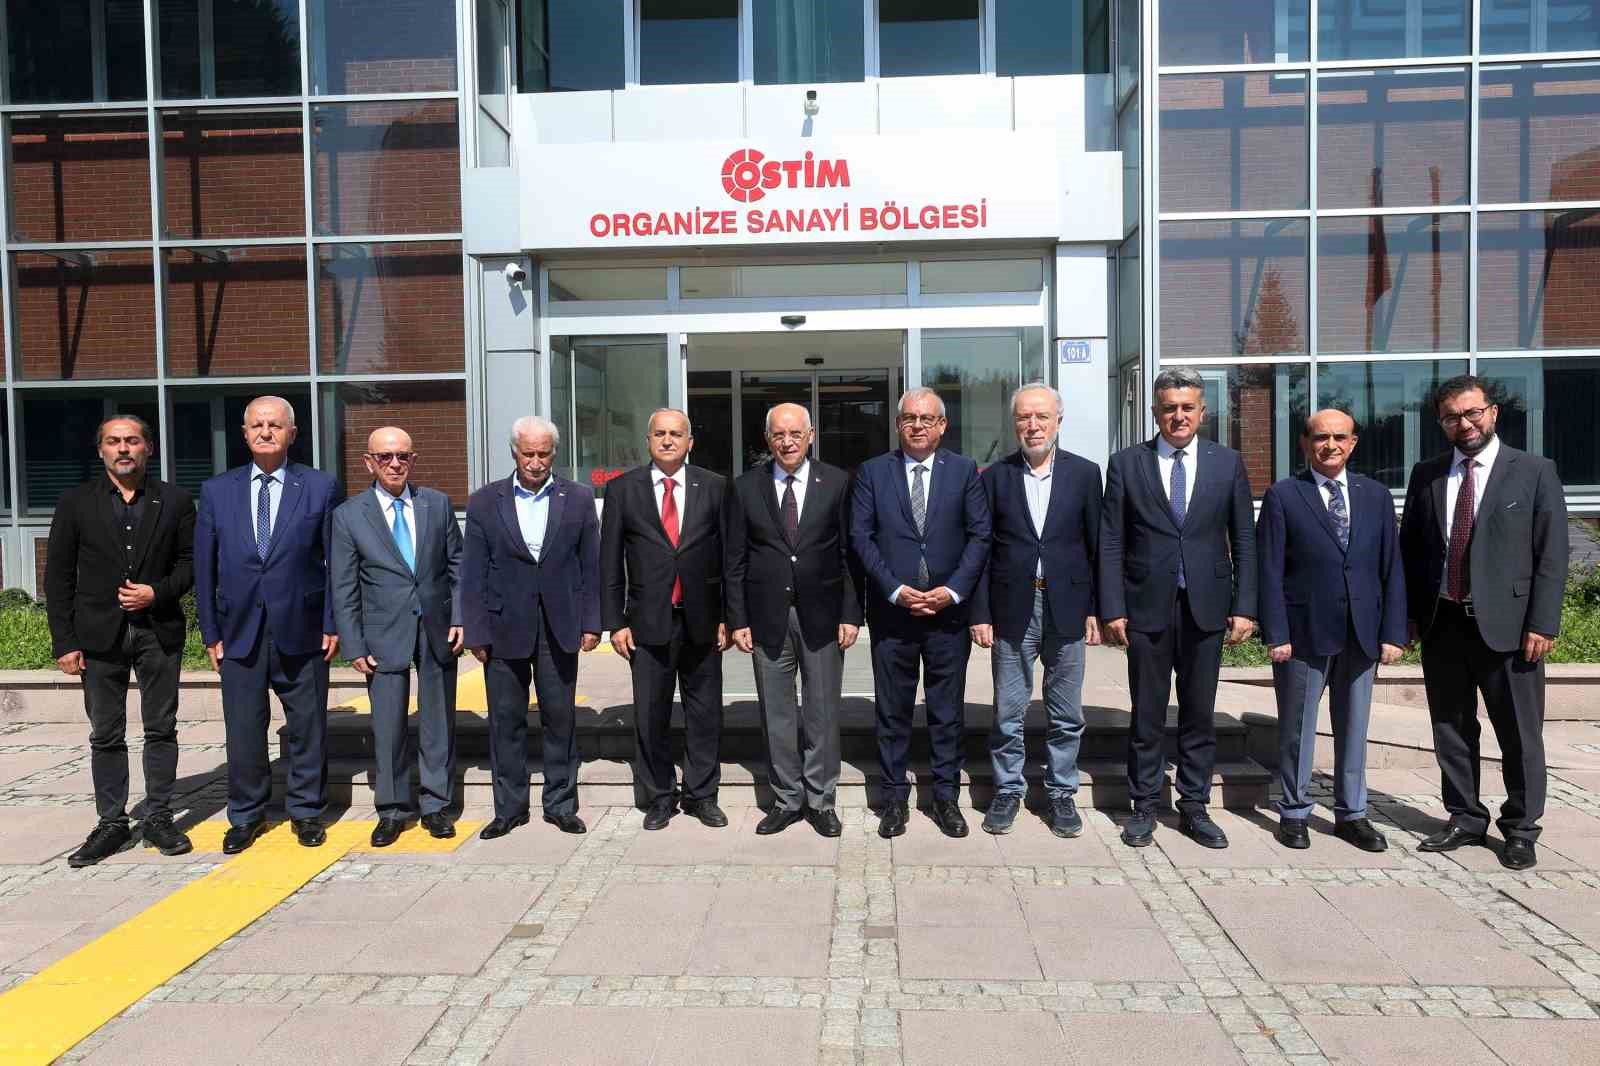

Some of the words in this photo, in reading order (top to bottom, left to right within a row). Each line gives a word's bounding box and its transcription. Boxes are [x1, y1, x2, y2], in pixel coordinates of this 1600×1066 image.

[733, 151, 850, 190] OSTİM
[590, 207, 736, 238] ORGANİZE
[747, 203, 849, 234] SANAYİ
[860, 199, 988, 231] BÖLGESİ
